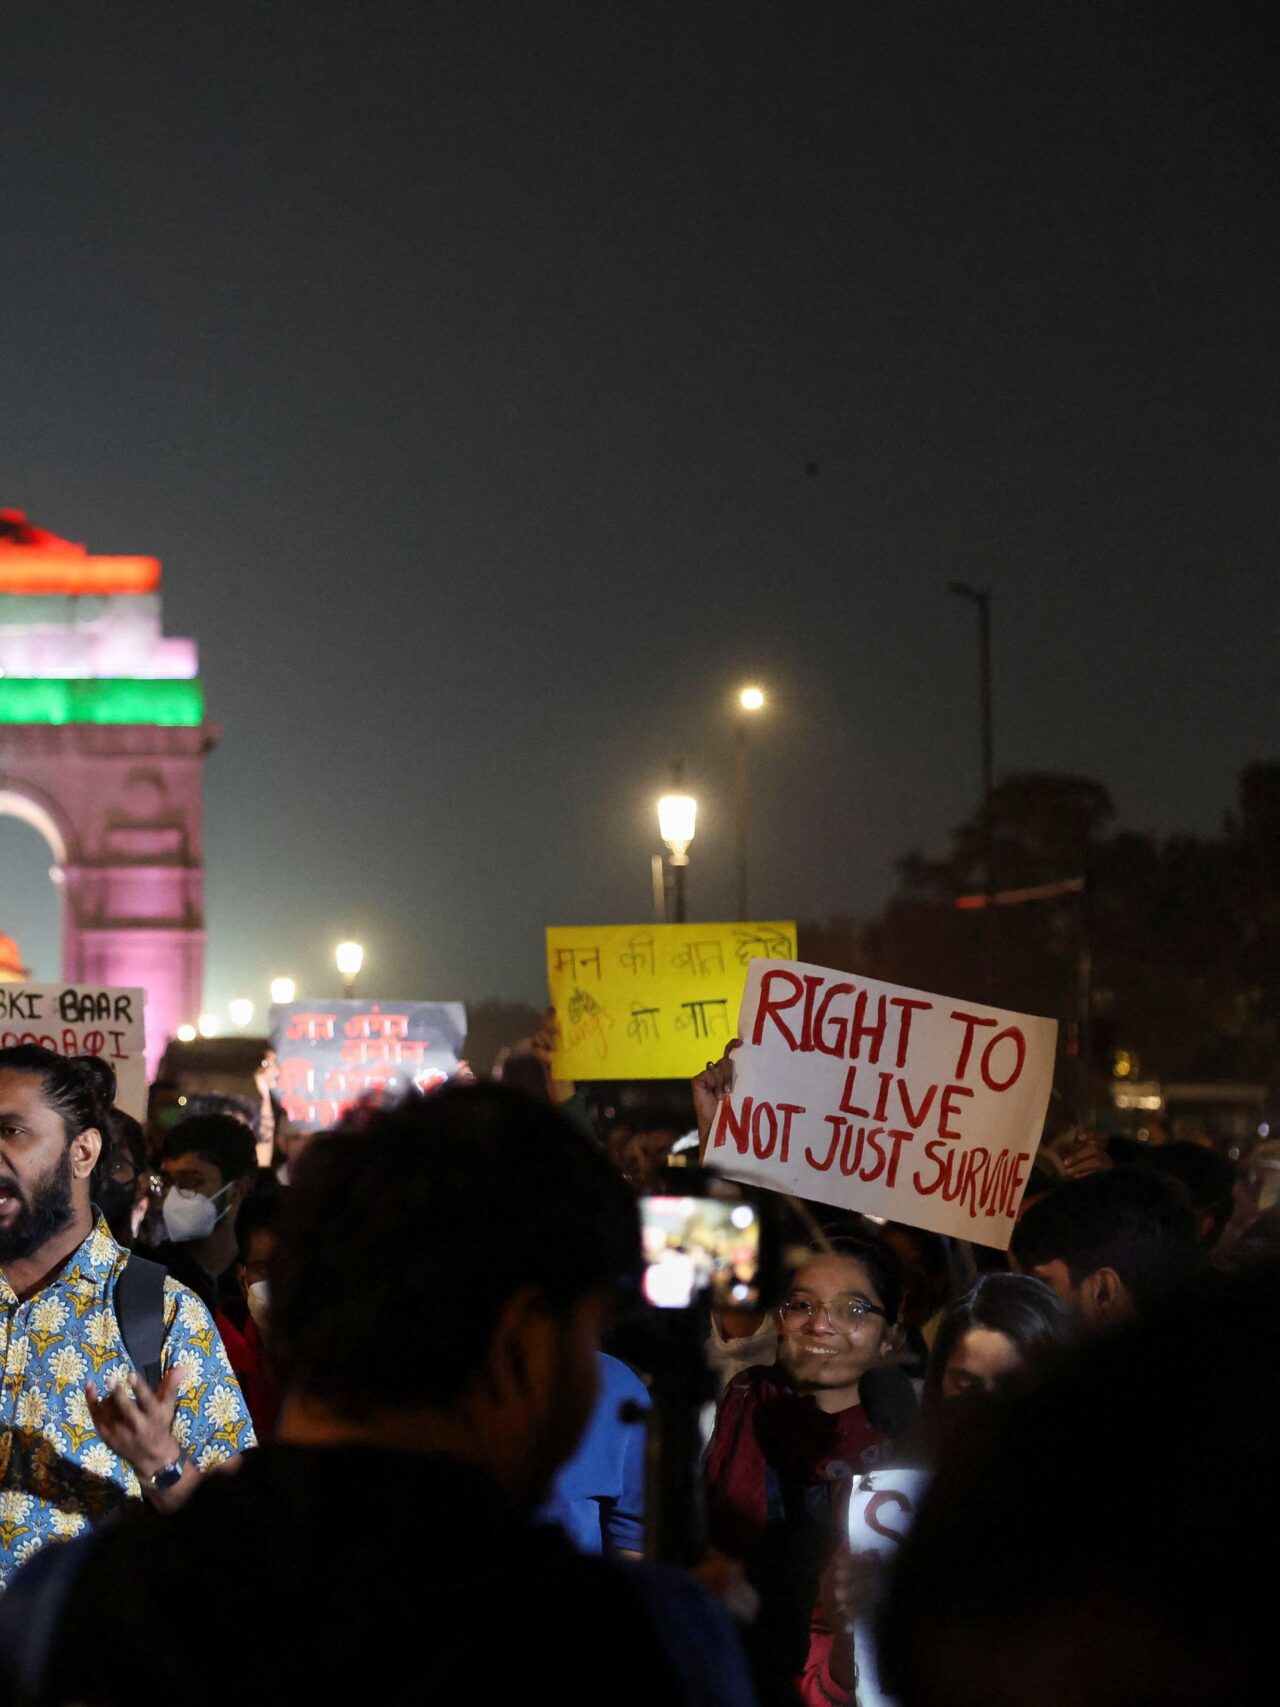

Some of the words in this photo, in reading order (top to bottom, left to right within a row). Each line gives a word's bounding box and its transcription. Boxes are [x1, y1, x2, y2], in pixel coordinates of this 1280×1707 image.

[554, 946, 602, 982] मन
[619, 930, 656, 976] की
[671, 940, 726, 976] बात
[59, 989, 134, 1024] BAAR
[752, 969, 933, 1068] RIGHT
[950, 1010, 1026, 1092] TO
[839, 1066, 974, 1140] LIVE
[714, 1096, 806, 1163] NOT
[805, 1115, 914, 1188] JUST
[913, 1139, 1030, 1218] SURVIVE
